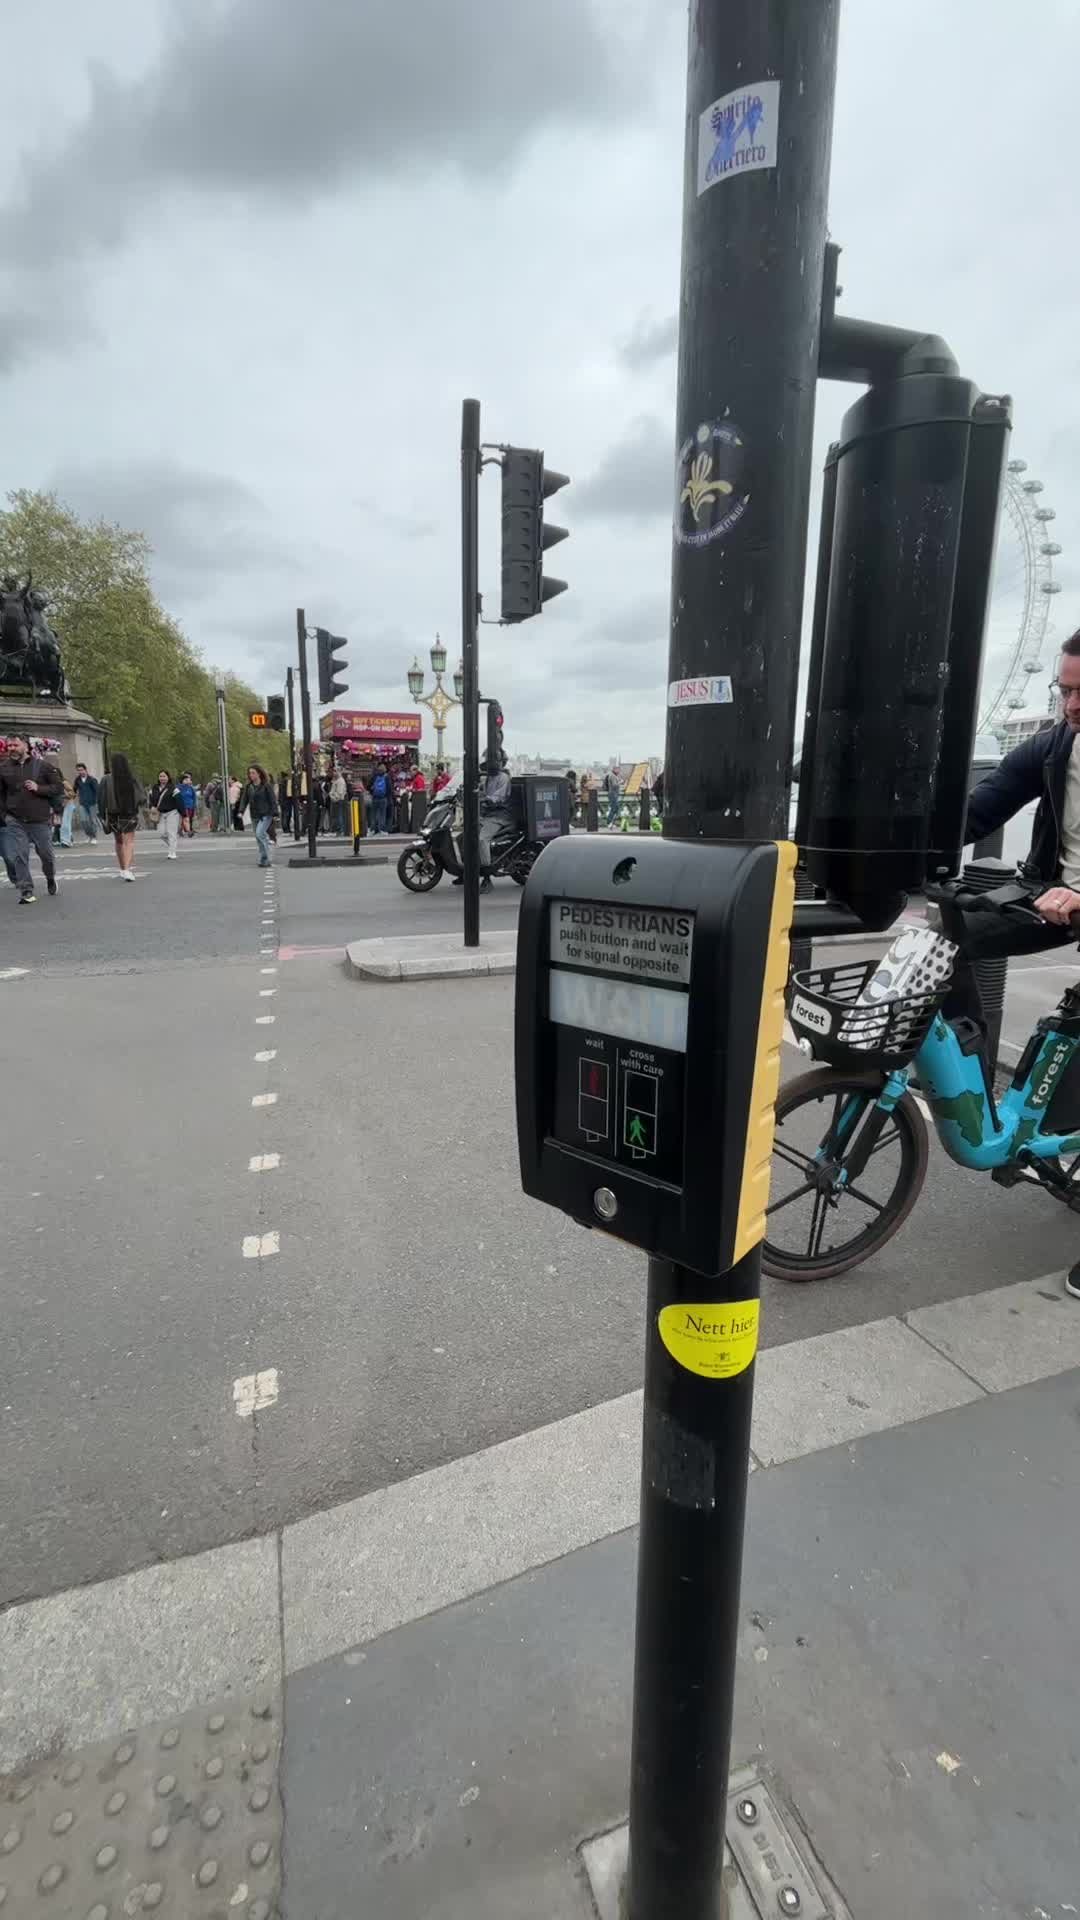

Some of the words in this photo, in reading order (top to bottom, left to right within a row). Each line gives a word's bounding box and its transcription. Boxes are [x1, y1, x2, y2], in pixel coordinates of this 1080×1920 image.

[560, 905, 690, 937] PEDESTRIANS
[560, 928, 587, 942] push
[590, 930, 629, 948] button
[632, 936, 656, 952] and
[659, 941, 689, 957] wait
[566, 943, 582, 958] for
[584, 948, 620, 964] signal
[623, 954, 680, 974] opposite
[796, 1002, 826, 1027] forest
[584, 1037, 605, 1050] wait
[629, 1048, 655, 1062] cross
[620, 1057, 641, 1071] with
[643, 1064, 664, 1077] care
[1032, 1042, 1069, 1104] forest
[685, 1313, 727, 1335] Nett
